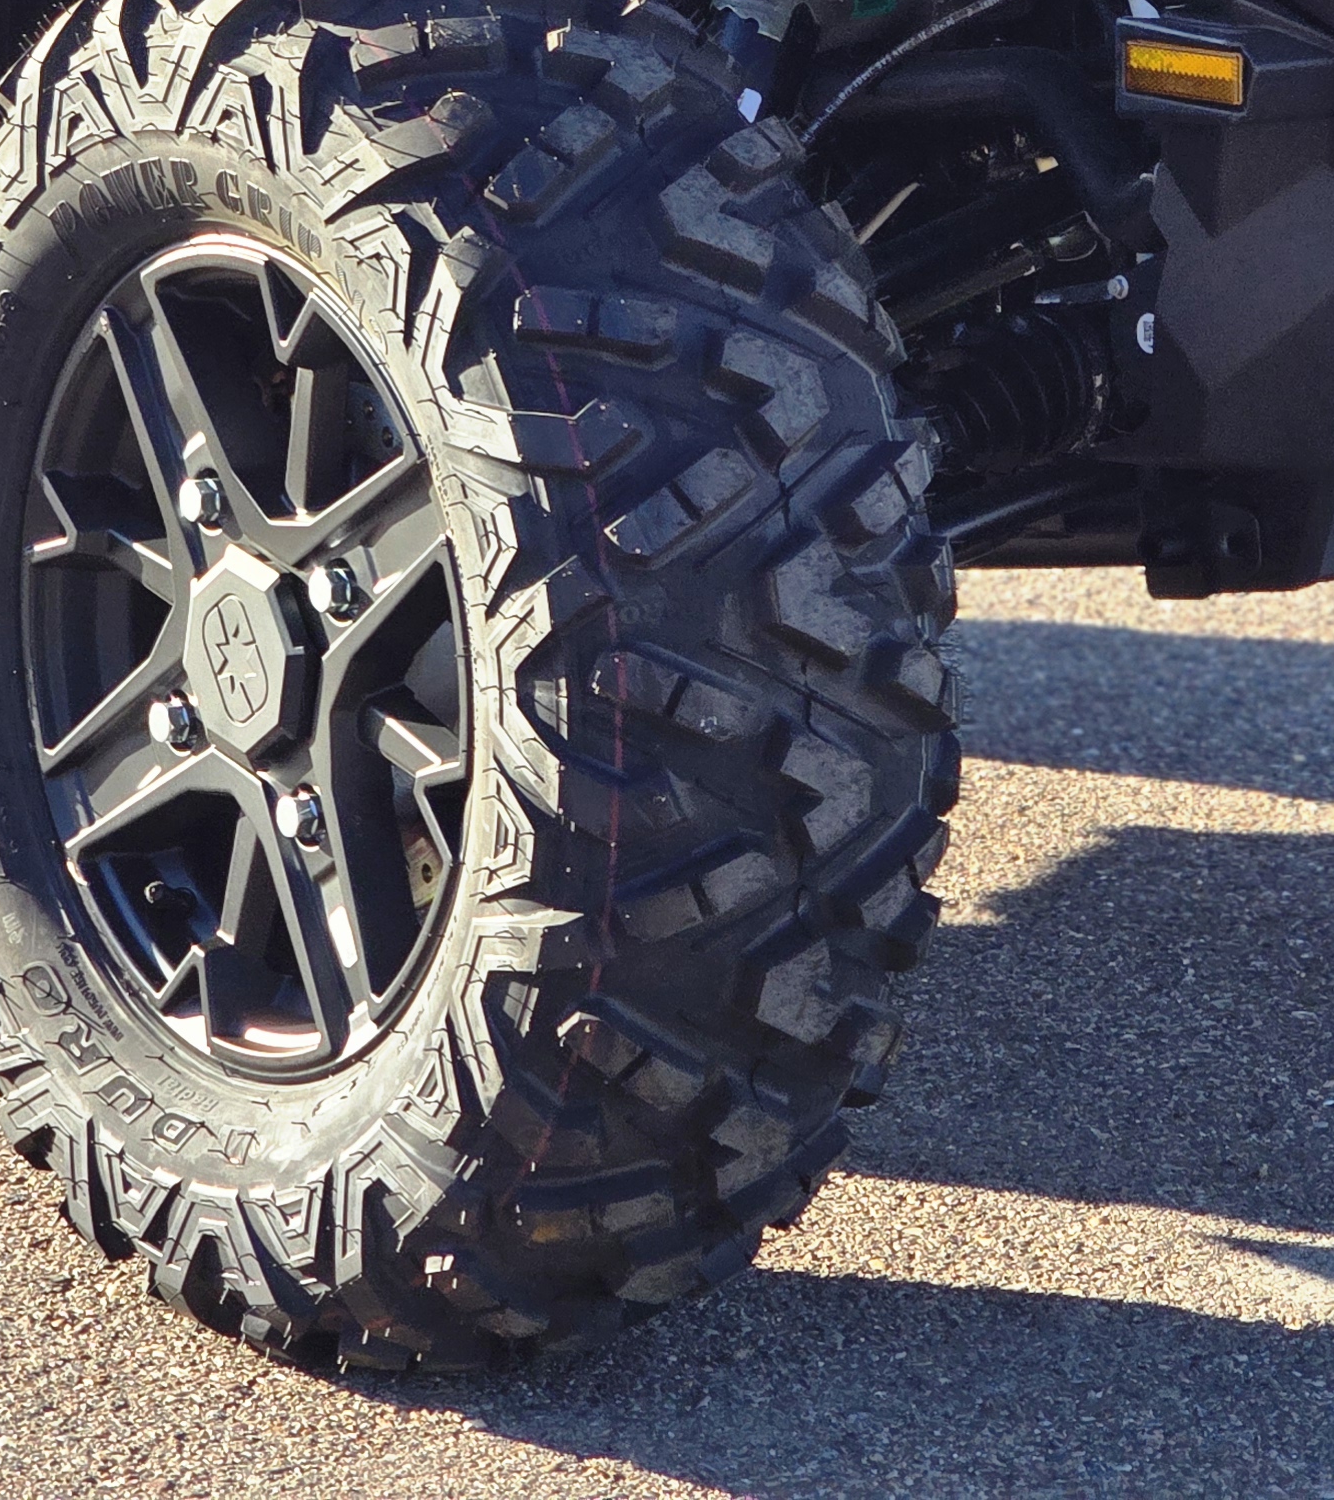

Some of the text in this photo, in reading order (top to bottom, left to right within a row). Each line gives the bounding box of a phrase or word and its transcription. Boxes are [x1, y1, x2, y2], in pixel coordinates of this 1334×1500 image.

[46, 155, 208, 247] POWER
[216, 168, 322, 262] GRIP
[20, 959, 205, 1156] DURO
[156, 1074, 220, 1113] Radial
